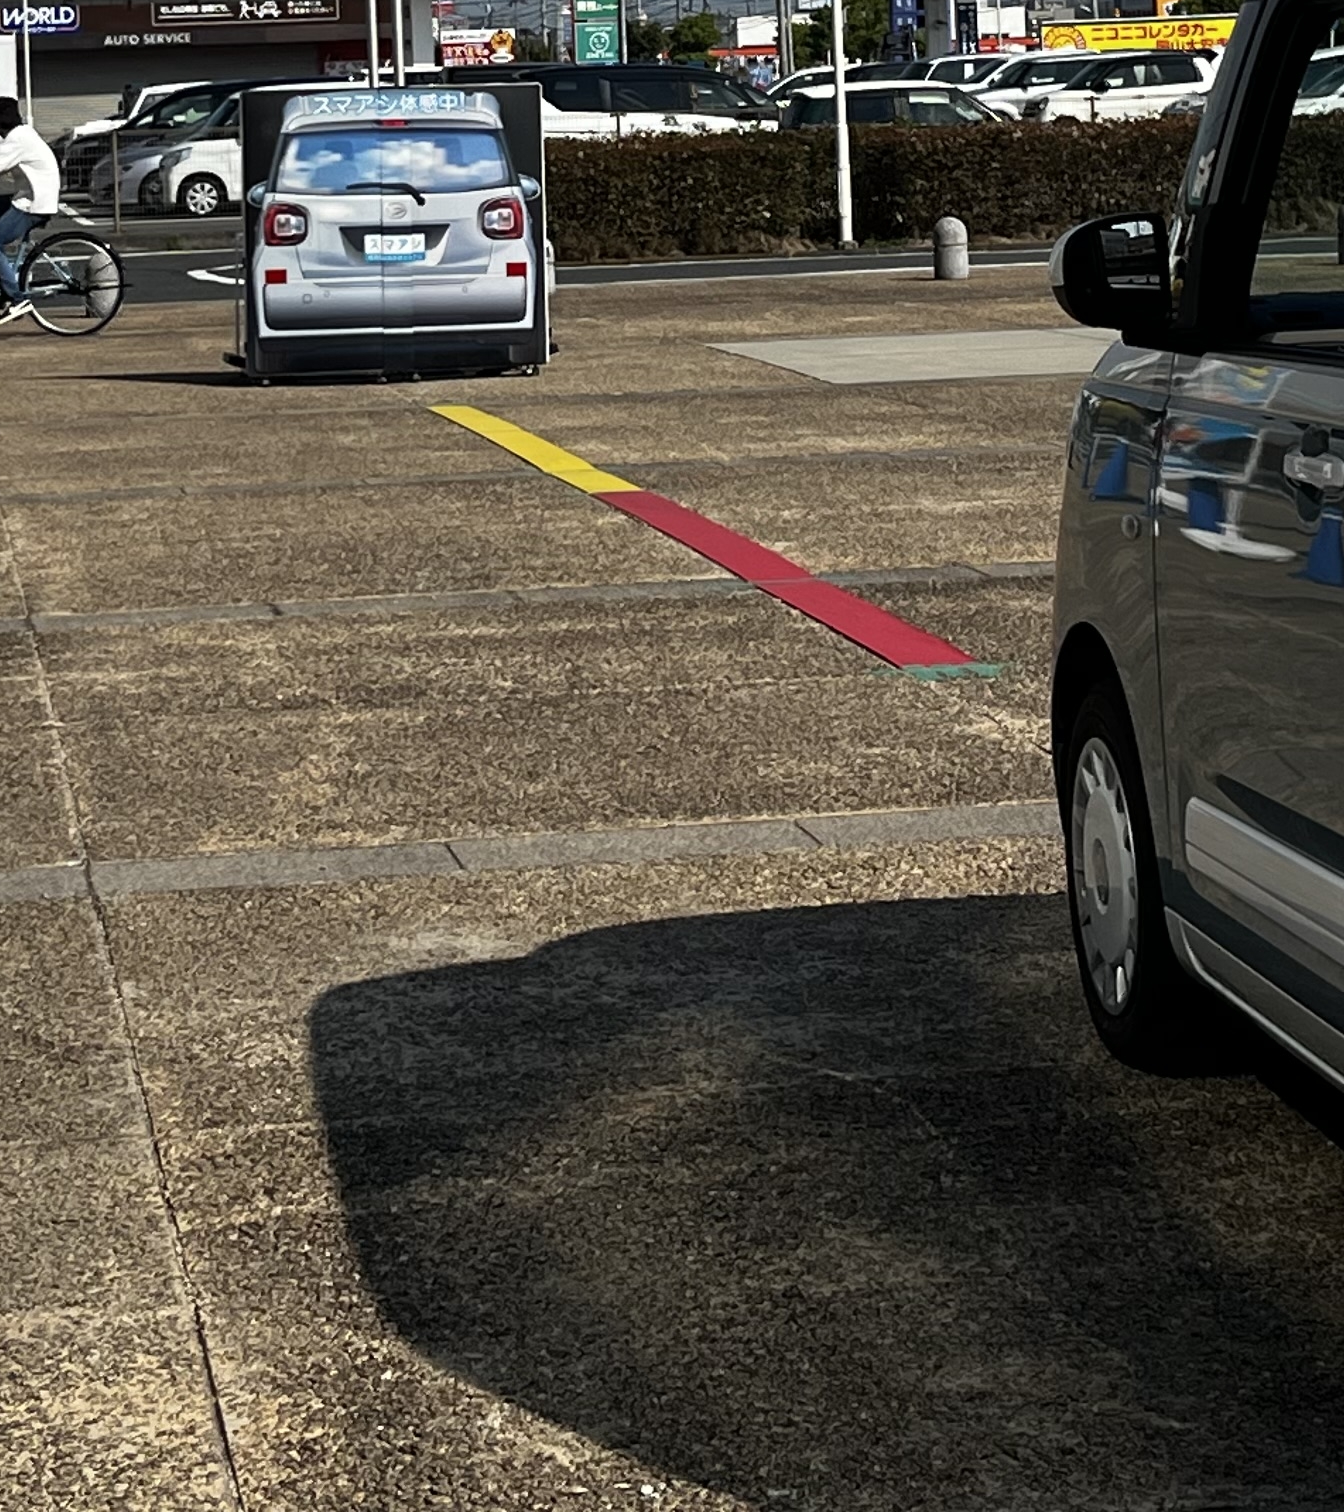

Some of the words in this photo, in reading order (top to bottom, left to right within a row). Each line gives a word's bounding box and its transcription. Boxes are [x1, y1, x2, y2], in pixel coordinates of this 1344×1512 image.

[3, 6, 75, 26] WORLD
[104, 35, 140, 46] AUTO
[143, 32, 191, 45] SERVICE
[1092, 24, 1218, 41] ニコニコレンタカー
